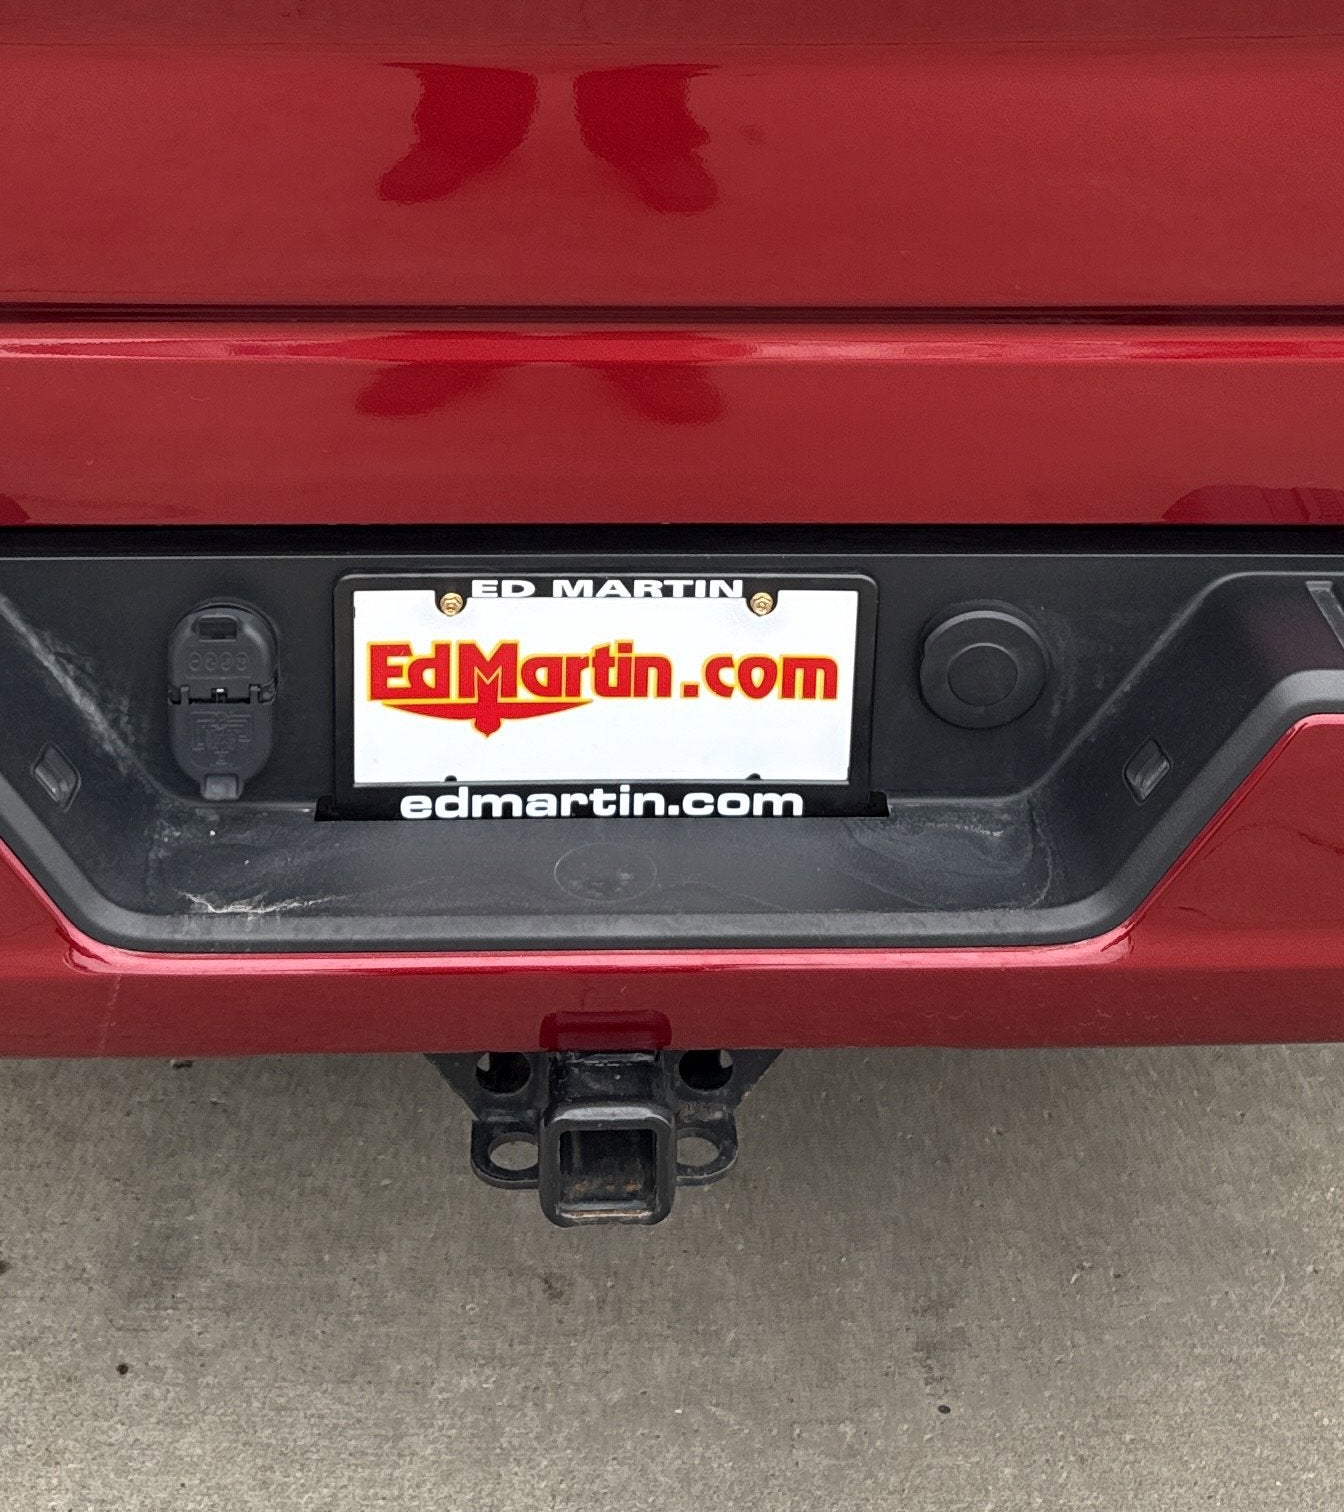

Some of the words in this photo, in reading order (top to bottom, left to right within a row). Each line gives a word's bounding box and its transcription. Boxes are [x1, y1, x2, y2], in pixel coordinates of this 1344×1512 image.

[470, 579, 536, 598] ED
[552, 579, 744, 598] MARTIN
[367, 639, 839, 703] EdMartin.com
[399, 785, 804, 820] edmartin.com
